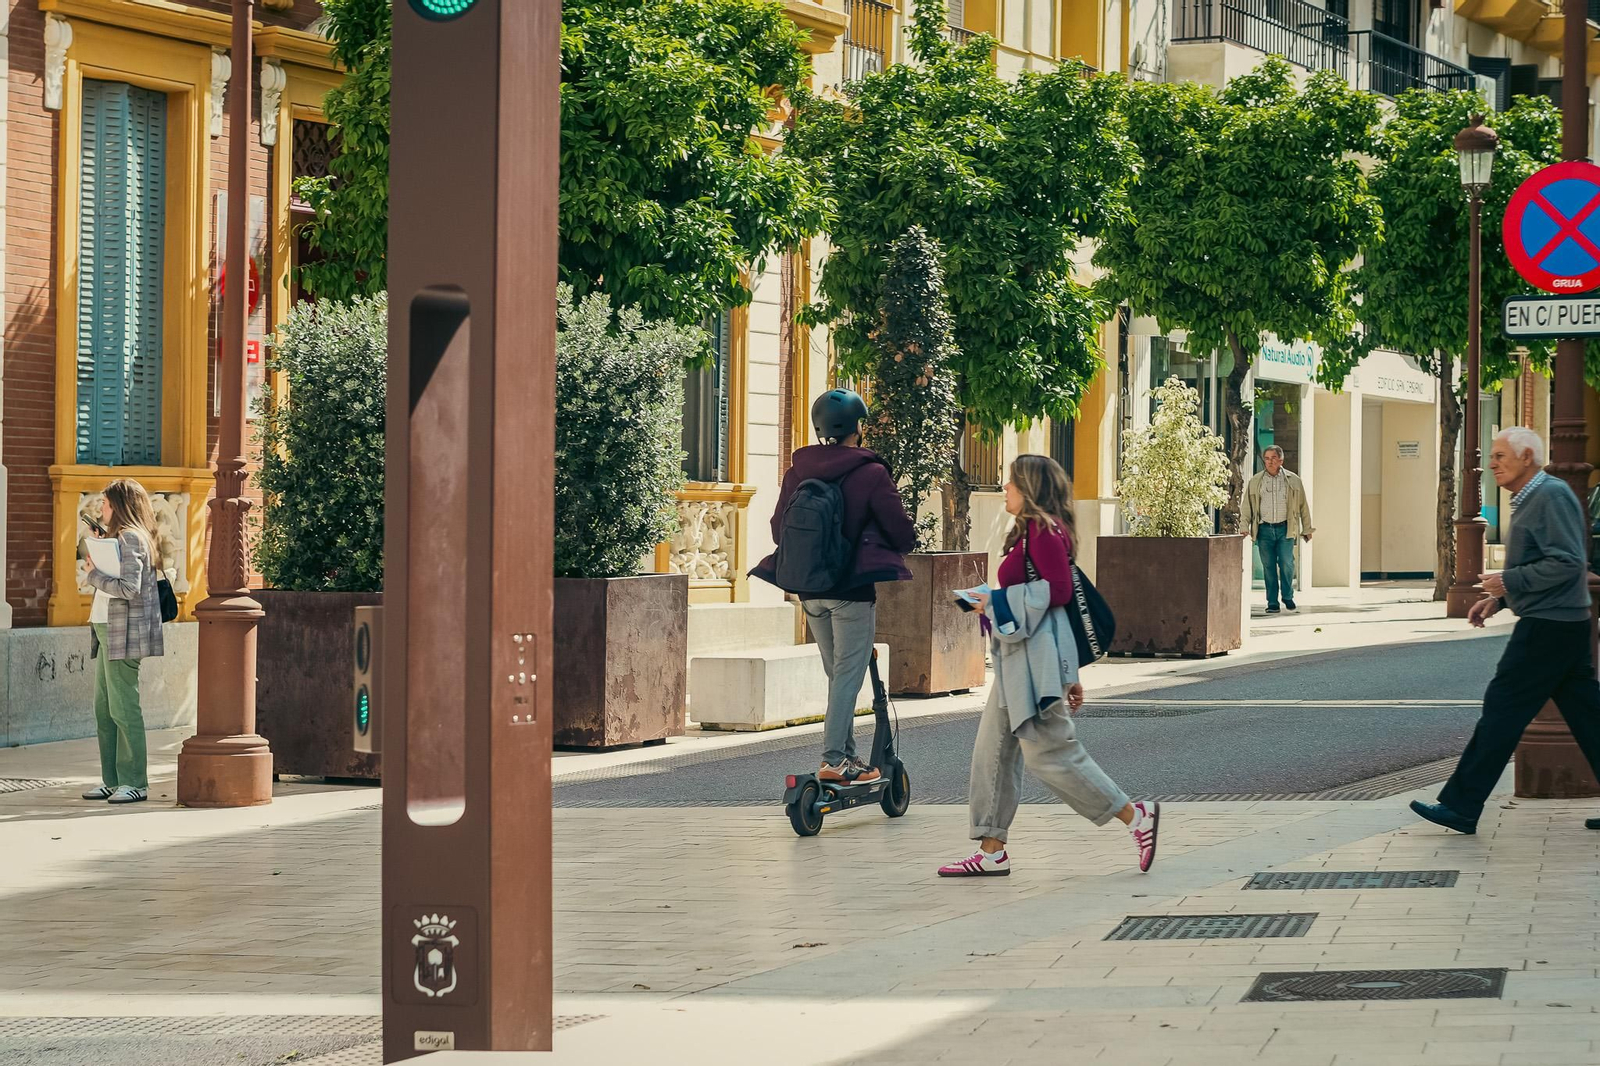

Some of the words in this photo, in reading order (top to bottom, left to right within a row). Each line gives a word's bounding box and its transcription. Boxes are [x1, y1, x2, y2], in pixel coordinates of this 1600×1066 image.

[1552, 279, 1583, 288] GRUA
[1508, 306, 1530, 327] EN
[1536, 305, 1553, 326] C/
[1262, 345, 1286, 364] Natural
[1287, 349, 1305, 366] Audio
[419, 1034, 449, 1047] edigal
